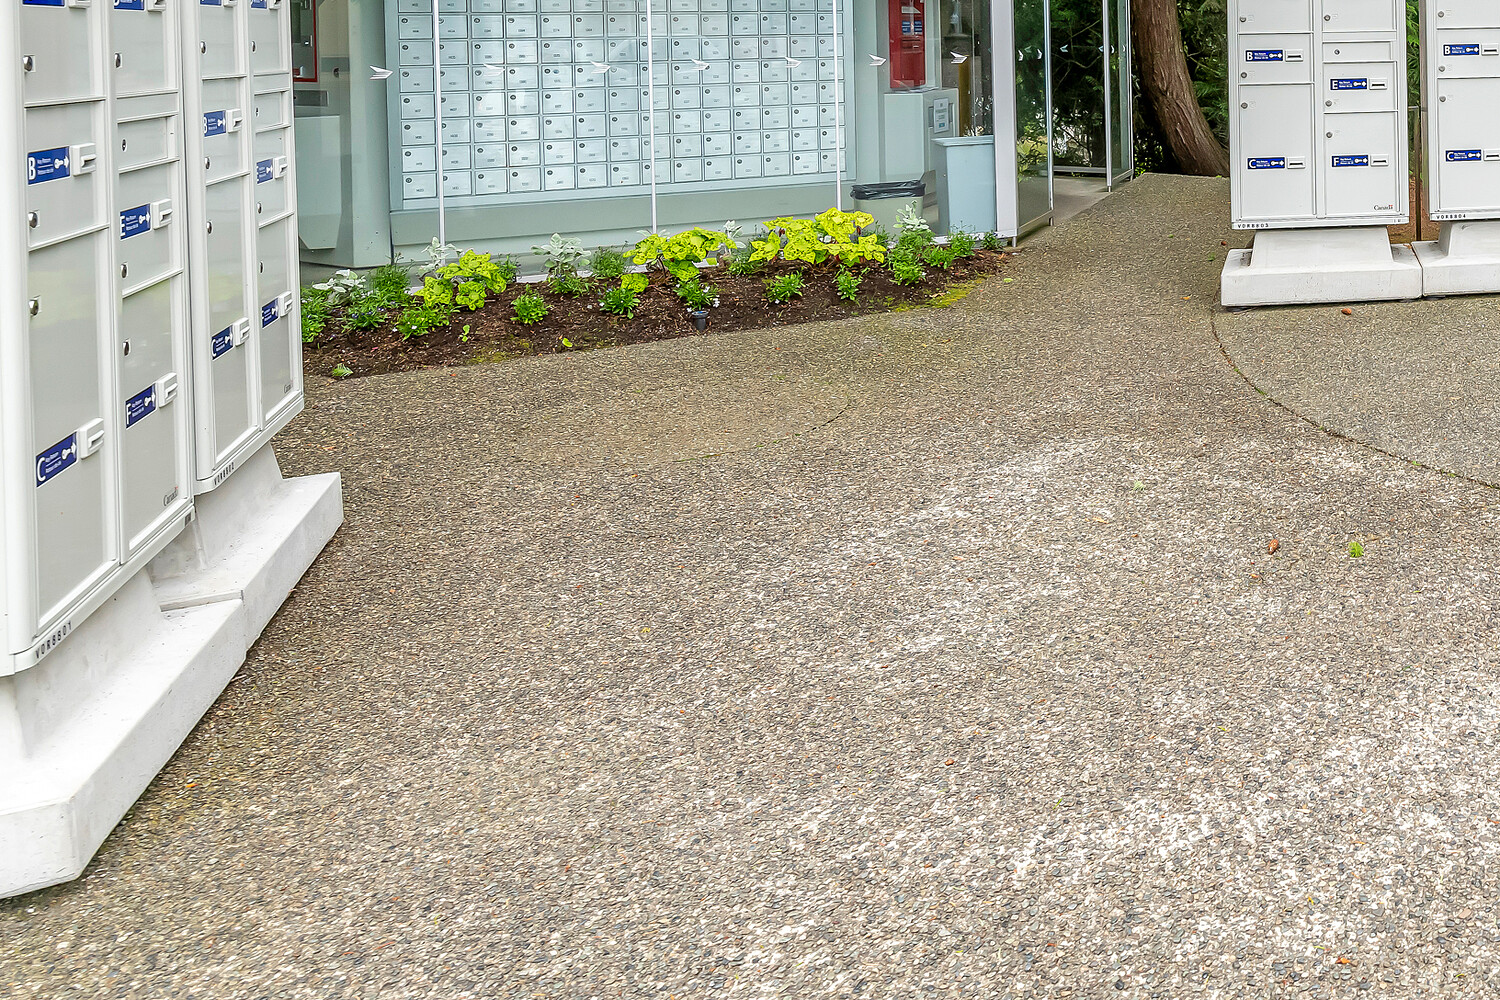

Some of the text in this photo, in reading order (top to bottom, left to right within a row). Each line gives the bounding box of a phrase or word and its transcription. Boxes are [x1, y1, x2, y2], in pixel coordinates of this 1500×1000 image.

[1444, 45, 1451, 55] B
[1246, 51, 1254, 61] B
[1332, 80, 1338, 89] E
[1446, 151, 1454, 161] C
[1248, 159, 1256, 168] C
[1333, 157, 1339, 166] F
[28, 157, 36, 180] B
[126, 402, 131, 425] F
[37, 457, 46, 482] C
